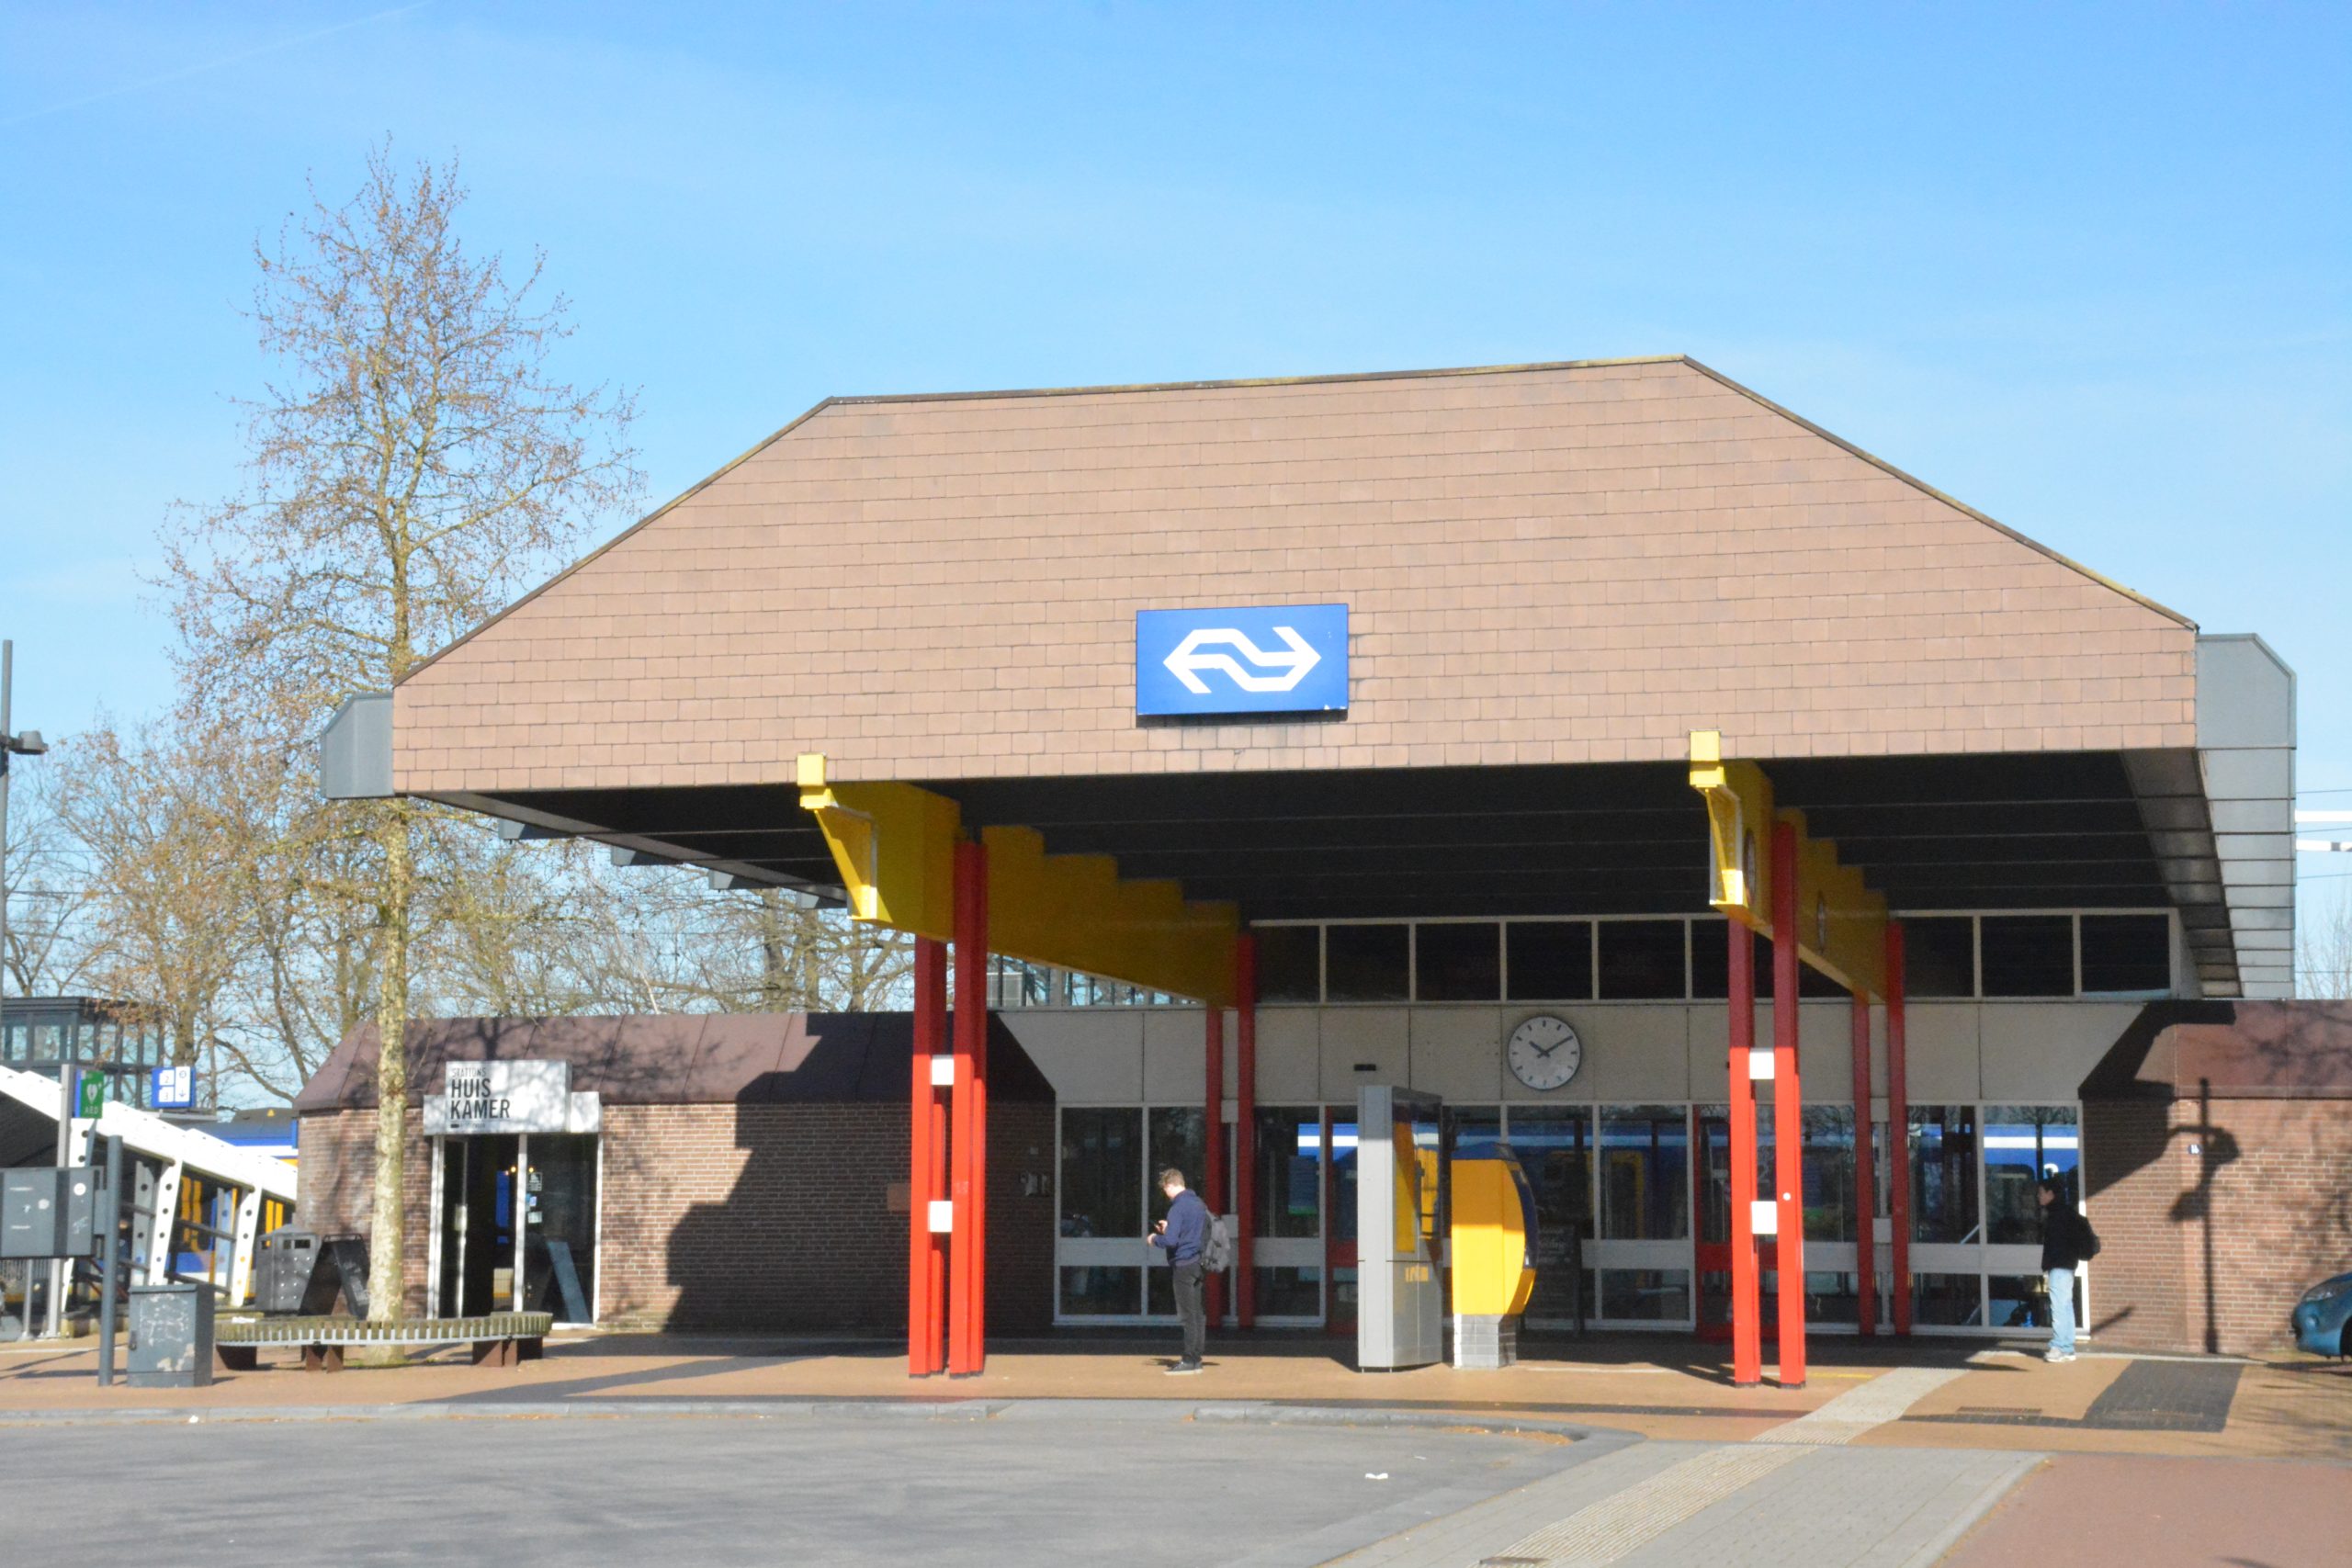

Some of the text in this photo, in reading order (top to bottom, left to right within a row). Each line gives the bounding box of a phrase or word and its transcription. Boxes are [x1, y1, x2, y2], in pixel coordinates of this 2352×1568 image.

[451, 1067, 487, 1077] STATIONS
[451, 1077, 492, 1099] HUIS
[84, 1105, 99, 1115] AED
[450, 1099, 511, 1120] KAMER
